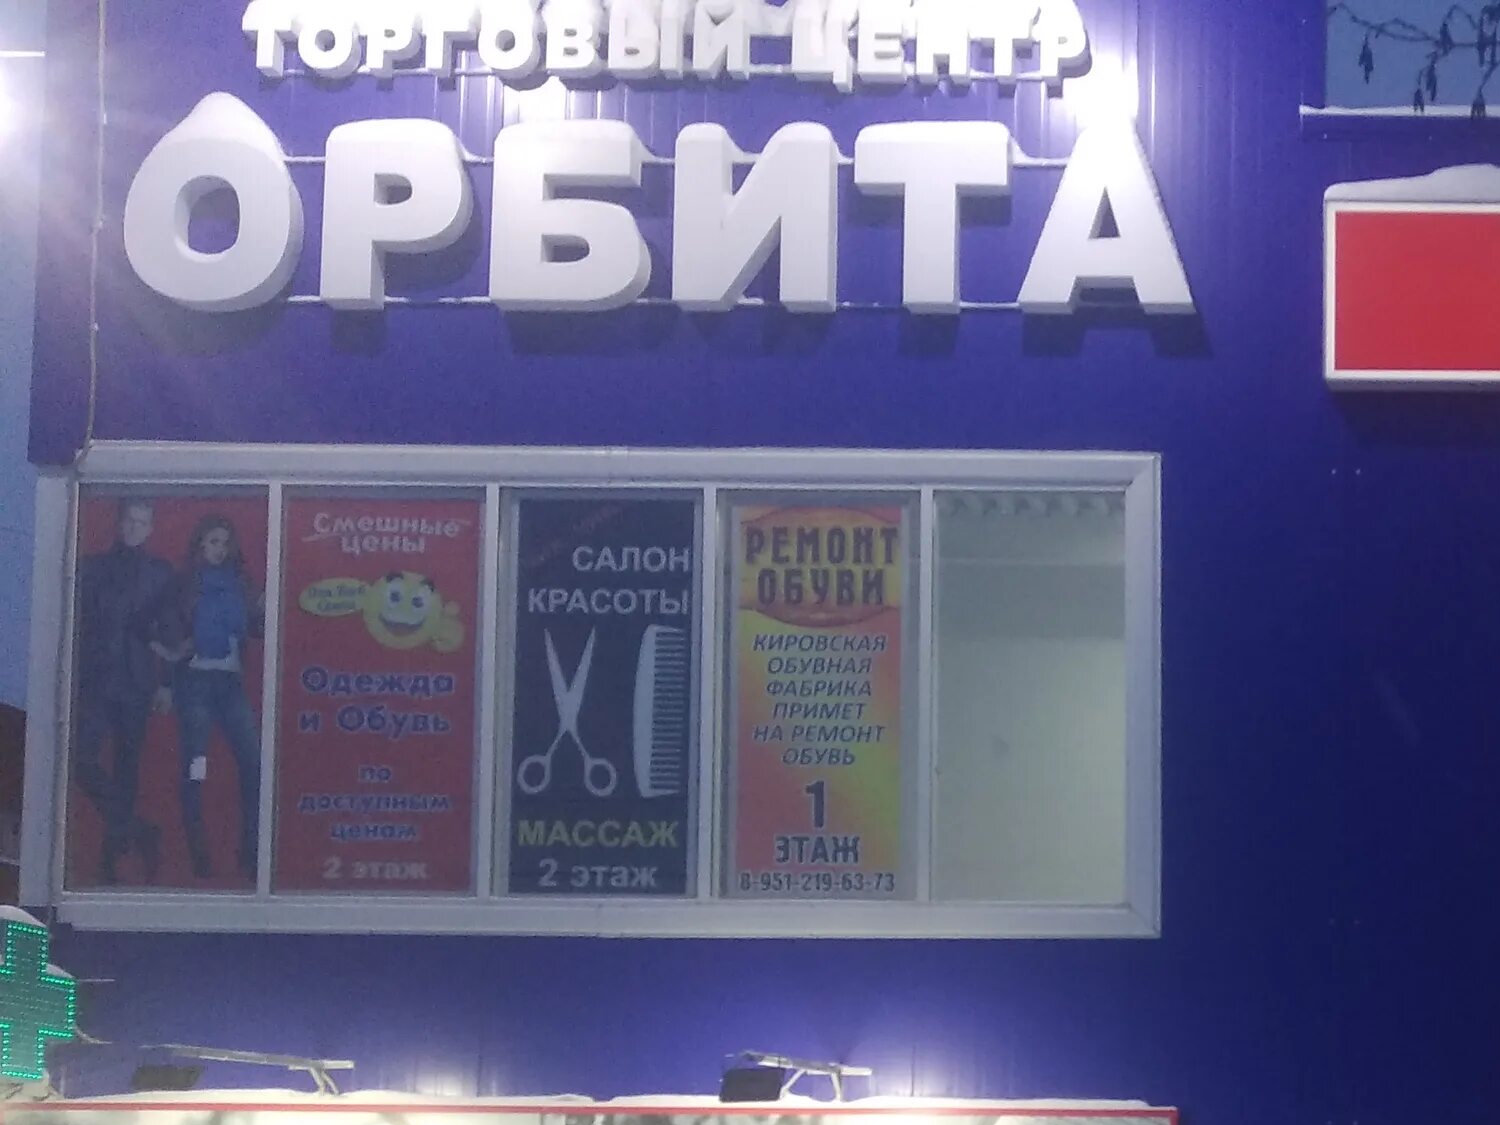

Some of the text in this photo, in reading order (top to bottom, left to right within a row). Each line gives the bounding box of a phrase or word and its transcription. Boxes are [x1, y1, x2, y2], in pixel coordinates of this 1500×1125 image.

[243, 0, 1092, 92] ТОРГОВЫЙ ЦЕНТР
[124, 108, 1196, 314] ОРБИТА
[313, 512, 460, 537] Смешные
[745, 526, 898, 564] РЕМОНТ
[572, 545, 691, 572] САЛОН
[758, 568, 884, 605] ОБУВИ
[528, 588, 689, 615] КРАСОТЫ
[753, 634, 887, 651] КИРОВСКАЯ
[767, 657, 873, 674] ОБУВНАЯ
[301, 665, 455, 697] Одежда
[767, 680, 872, 697] ФАБРИКА
[299, 704, 451, 741] и Обувь
[772, 702, 867, 720] ПРИМЕТ
[753, 725, 887, 743] НА РЕМОНТ
[782, 748, 856, 765] ОБУВЬ
[359, 765, 392, 783] по
[298, 794, 451, 815] доступным
[805, 780, 826, 829] 1
[330, 824, 418, 842] ценам
[518, 820, 679, 848] МАССАЖ
[775, 836, 861, 864] ЭТАЖ
[322, 855, 429, 880] 2 этаж
[538, 858, 658, 888] 2 этаж
[739, 872, 896, 892] 8-951-219-63-73
